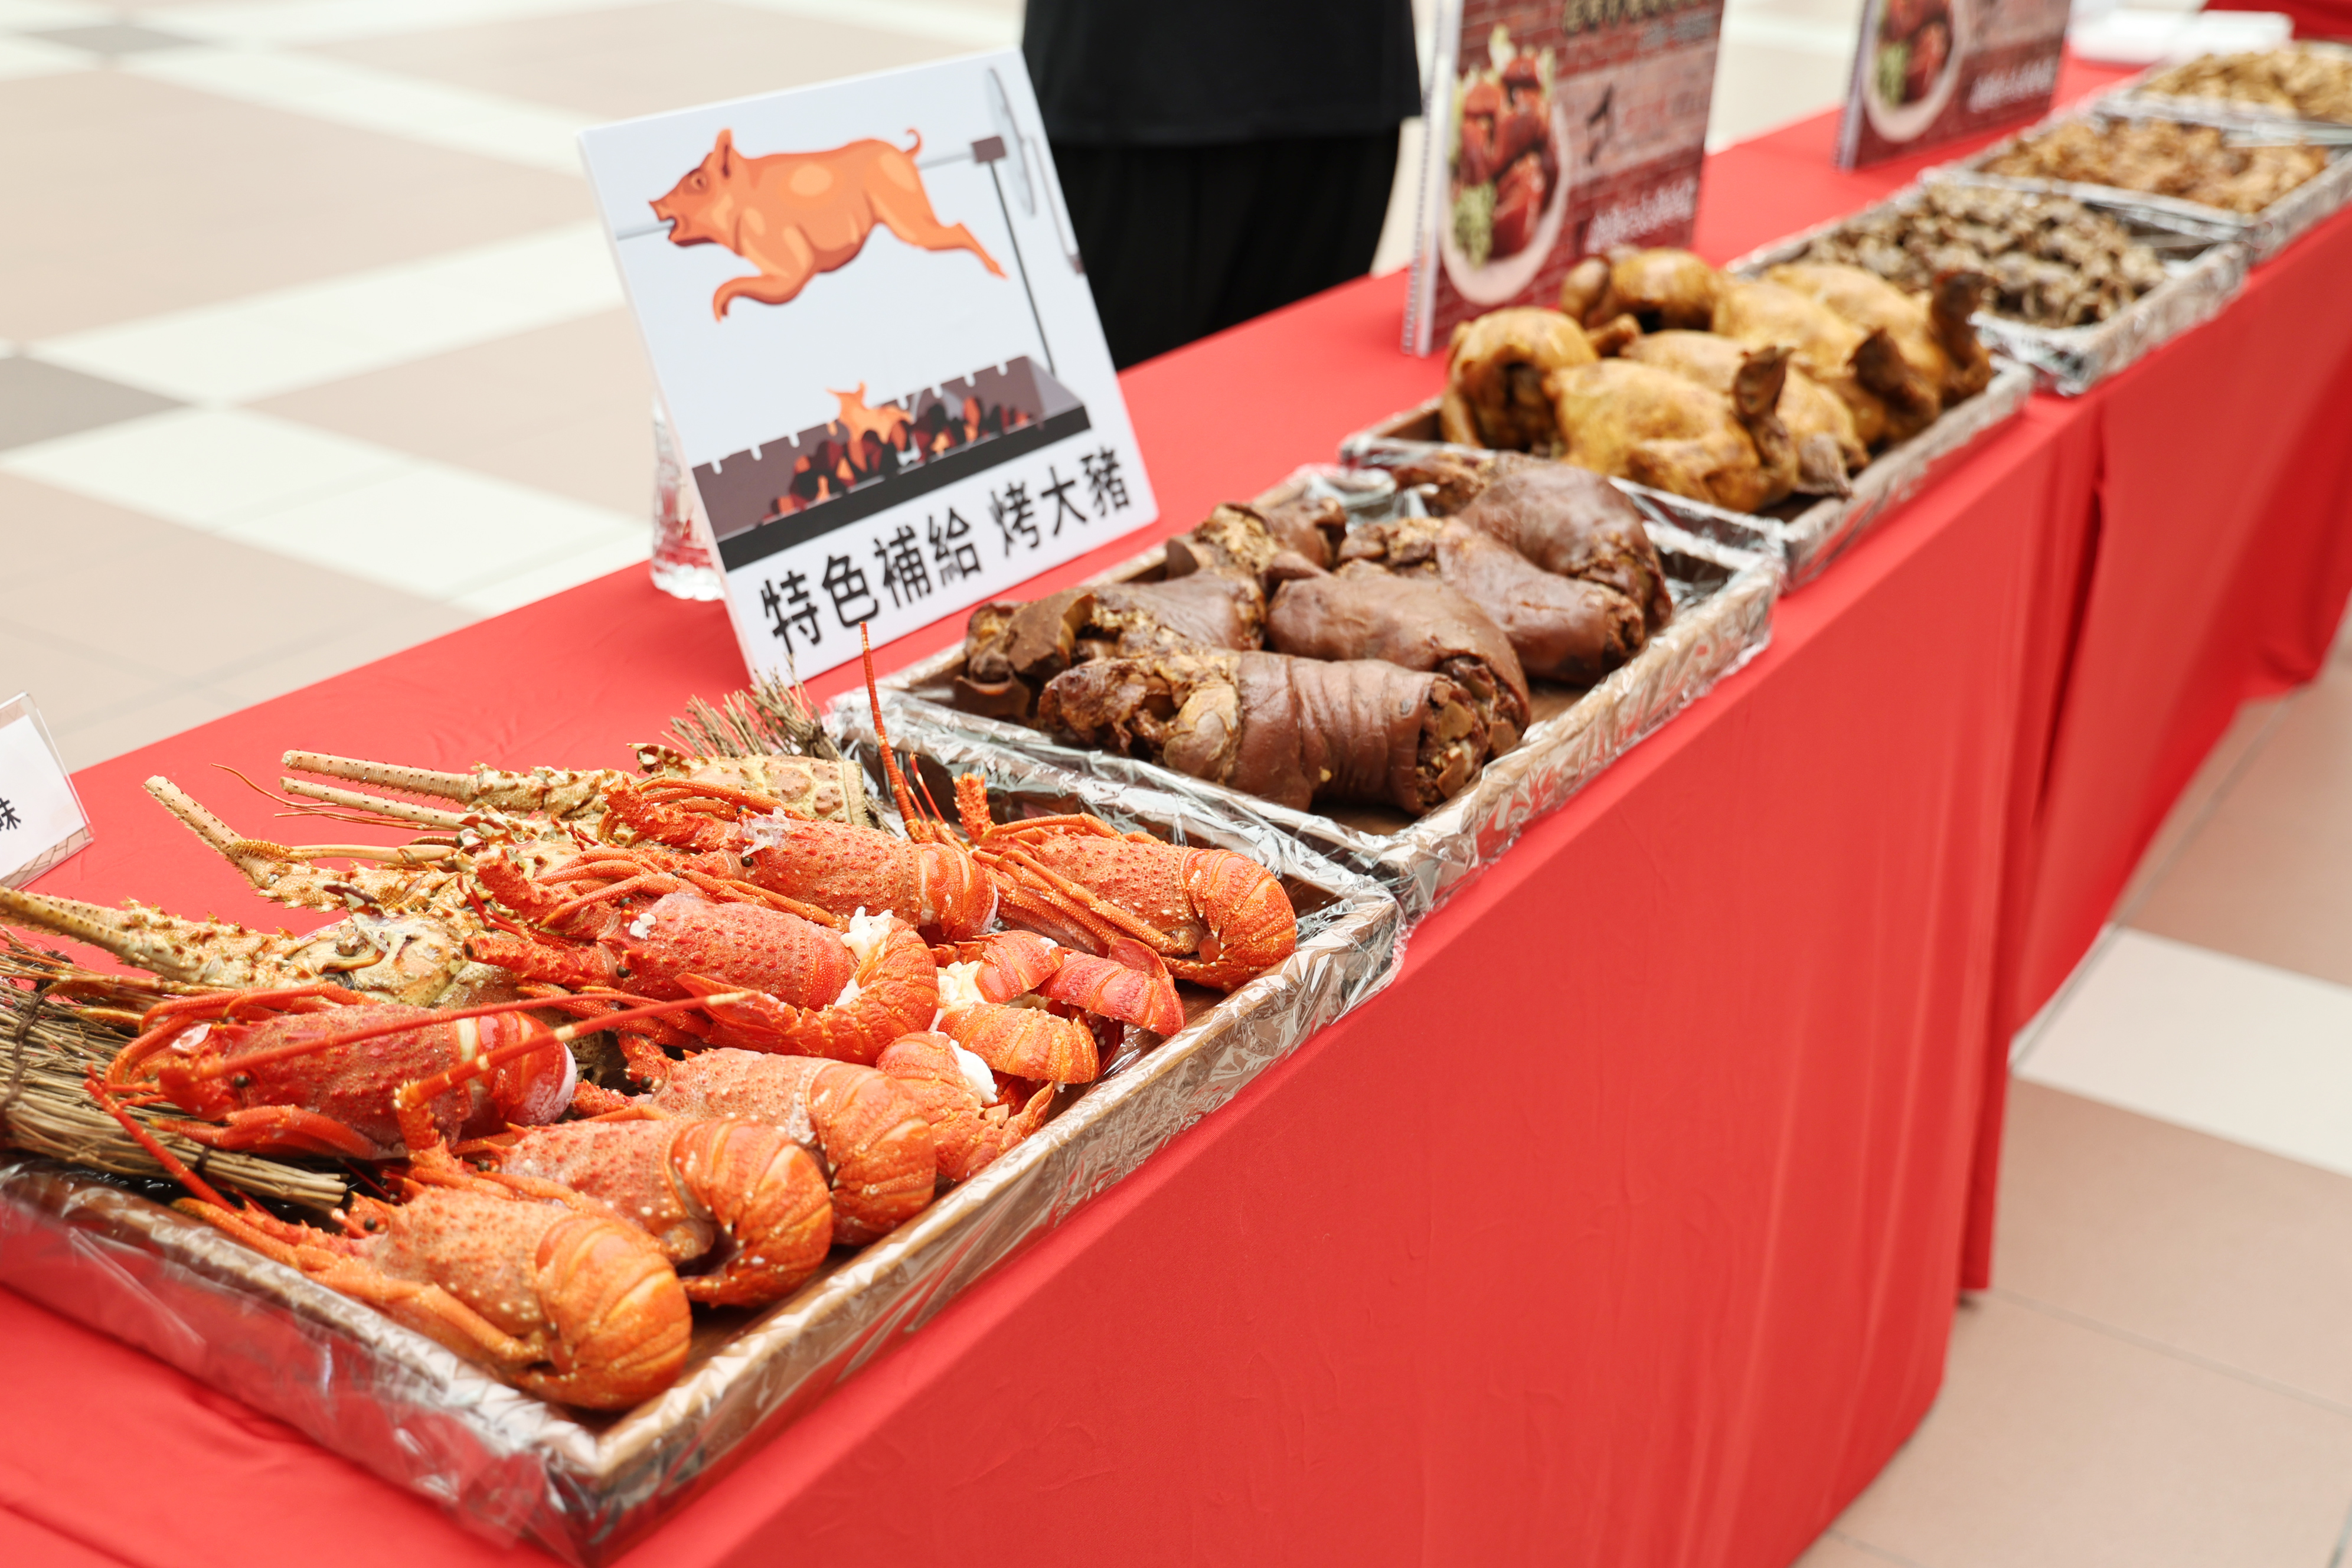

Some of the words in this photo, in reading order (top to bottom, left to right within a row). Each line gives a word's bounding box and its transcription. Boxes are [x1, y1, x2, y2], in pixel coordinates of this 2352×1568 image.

[760, 507, 982, 654] 特色補給
[989, 447, 1130, 556] 烤大豬
